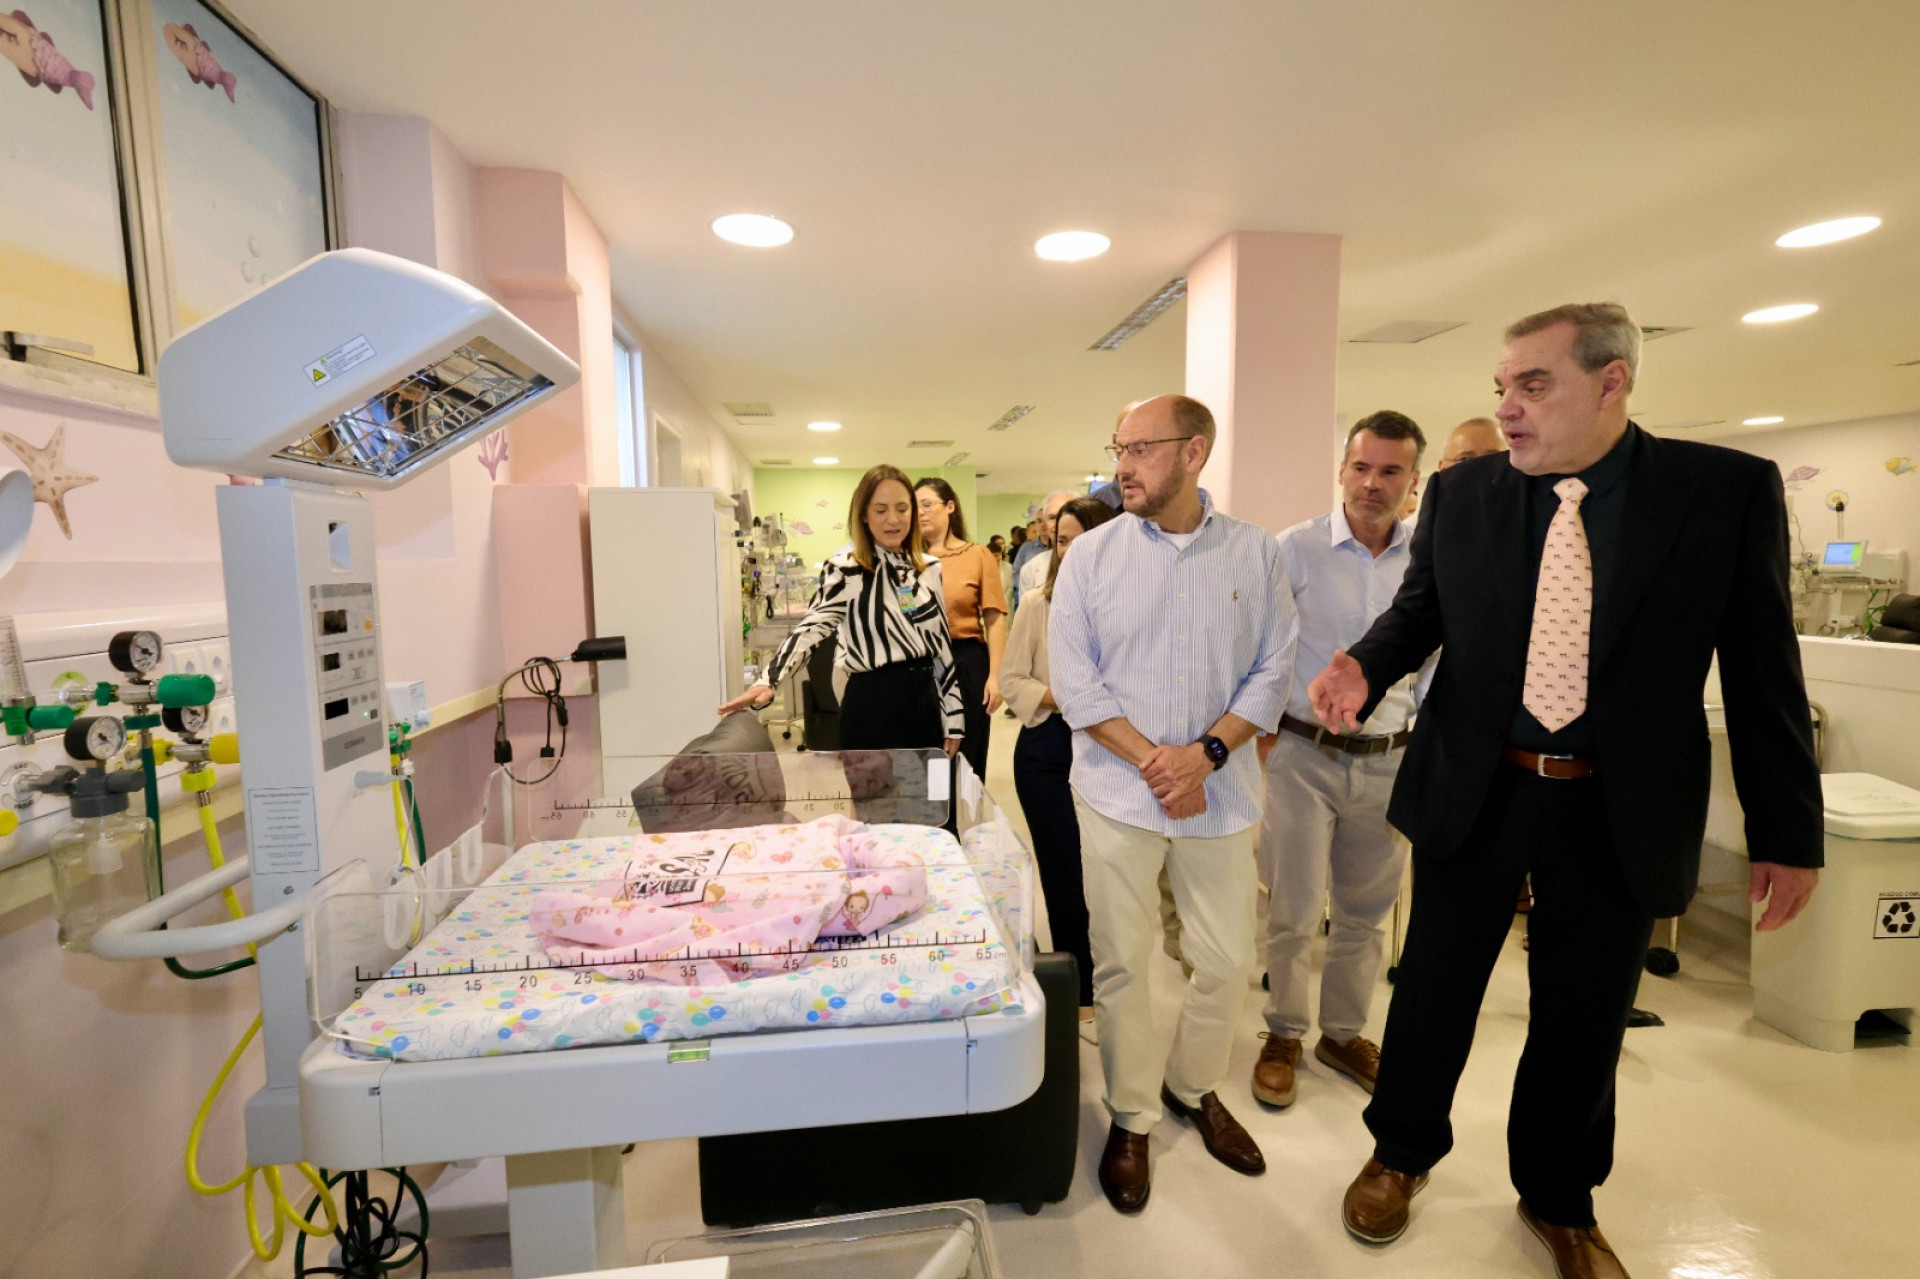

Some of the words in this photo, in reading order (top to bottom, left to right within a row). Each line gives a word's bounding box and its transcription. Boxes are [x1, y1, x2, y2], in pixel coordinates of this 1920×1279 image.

[354, 986, 363, 999] 5
[407, 983, 426, 996] 10
[464, 979, 482, 992] 15
[519, 975, 538, 988] 20
[574, 971, 593, 985] 25
[627, 968, 645, 981] 30
[680, 965, 697, 978] 35
[731, 961, 749, 974] 40
[782, 958, 800, 971] 45
[832, 955, 848, 968] 50
[881, 953, 897, 965] 55
[928, 949, 945, 962] 60
[976, 947, 992, 960] 65
